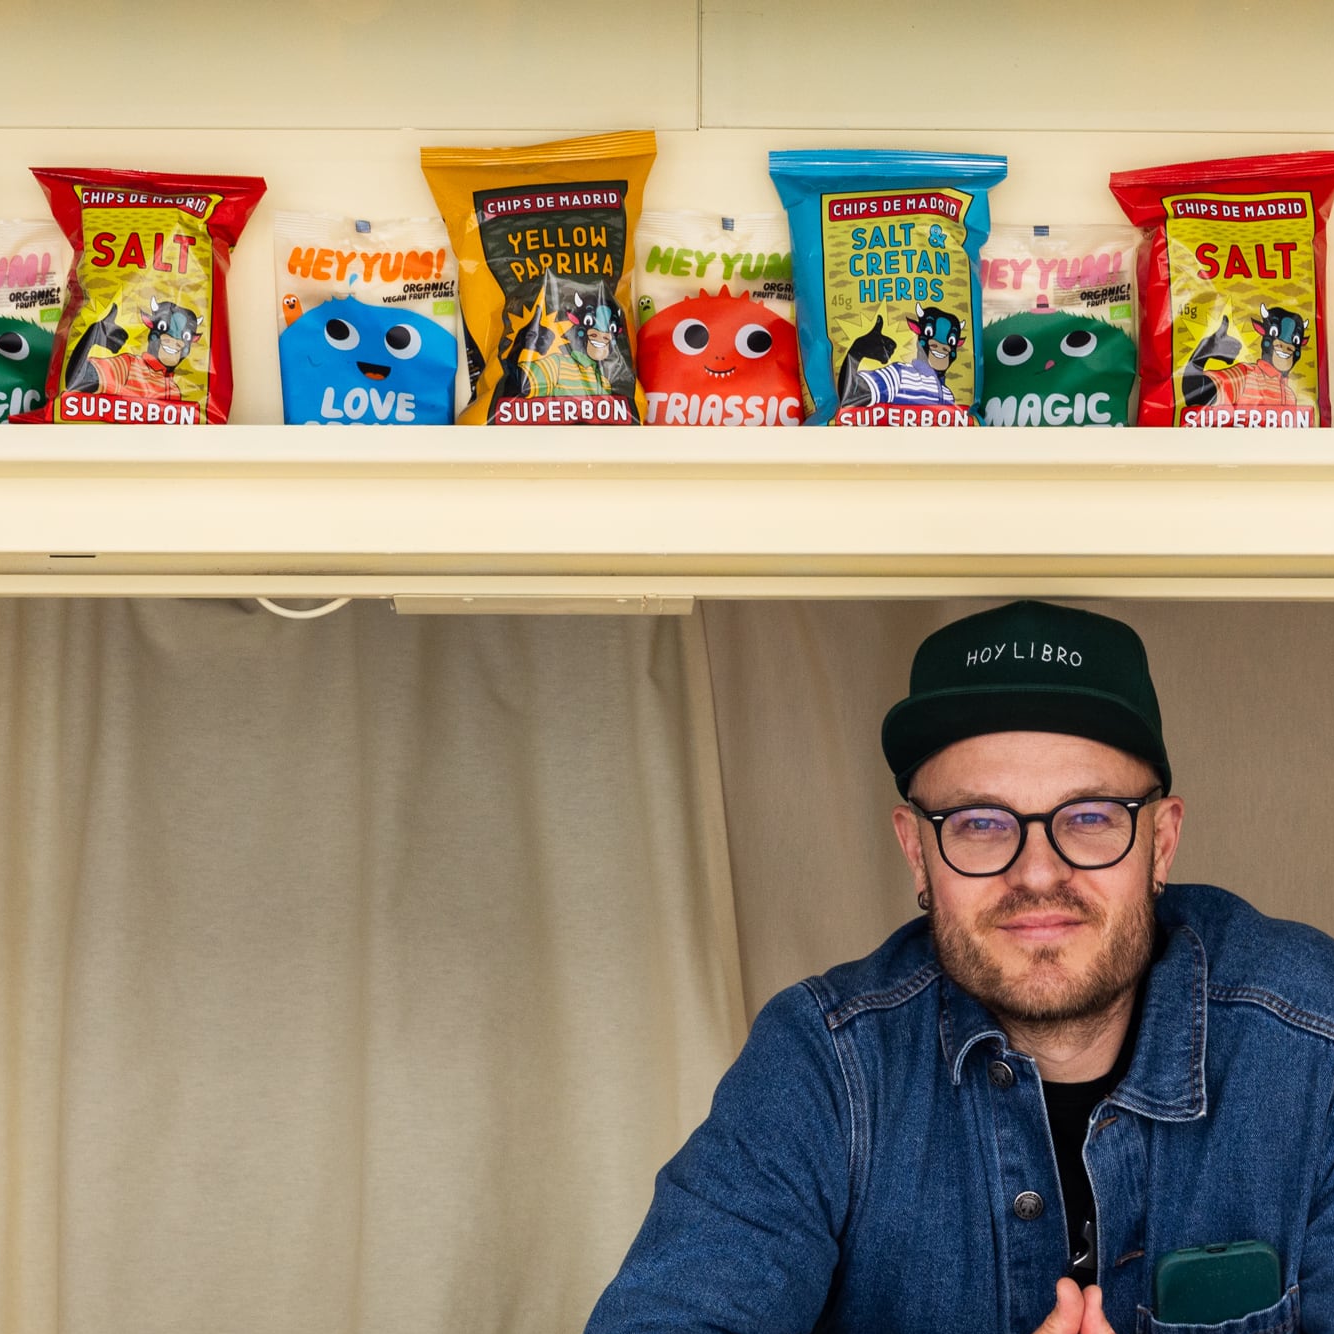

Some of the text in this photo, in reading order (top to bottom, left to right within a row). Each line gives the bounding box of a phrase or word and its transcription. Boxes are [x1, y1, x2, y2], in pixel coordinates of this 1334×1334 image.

[488, 193, 617, 213] CHIPS DE MADRID
[508, 227, 606, 254] YELLOW
[510, 253, 613, 282] PAPRIKA
[499, 400, 628, 422] SUPERBON
[647, 393, 800, 424] TRIASSIC
[967, 642, 1082, 666] HOY LIBRO
